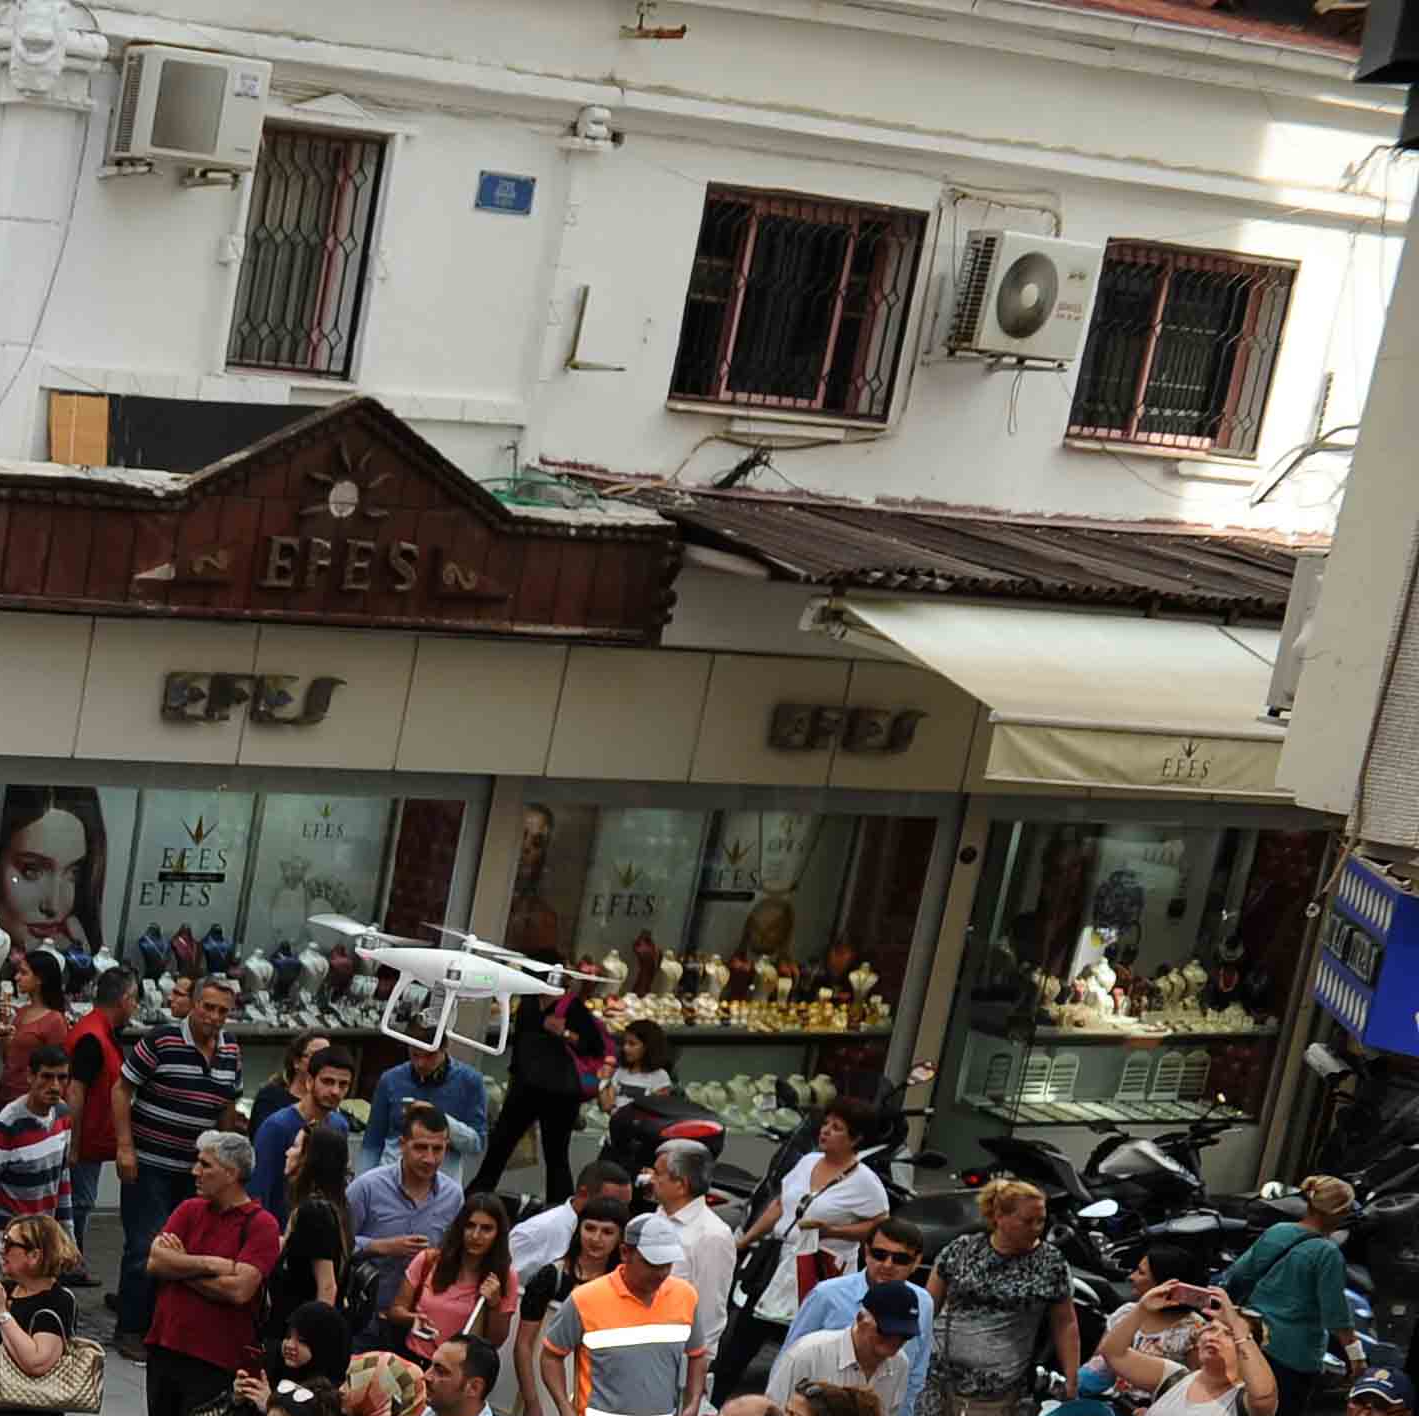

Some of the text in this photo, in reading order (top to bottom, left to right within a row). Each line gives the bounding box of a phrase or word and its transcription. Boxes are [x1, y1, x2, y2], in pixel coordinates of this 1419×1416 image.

[260, 536, 420, 591] EFES
[161, 671, 348, 725] EFES
[1162, 757, 1211, 778] EFES
[302, 822, 346, 840] EFES
[160, 847, 228, 870] EFES
[139, 882, 212, 907] EFES
